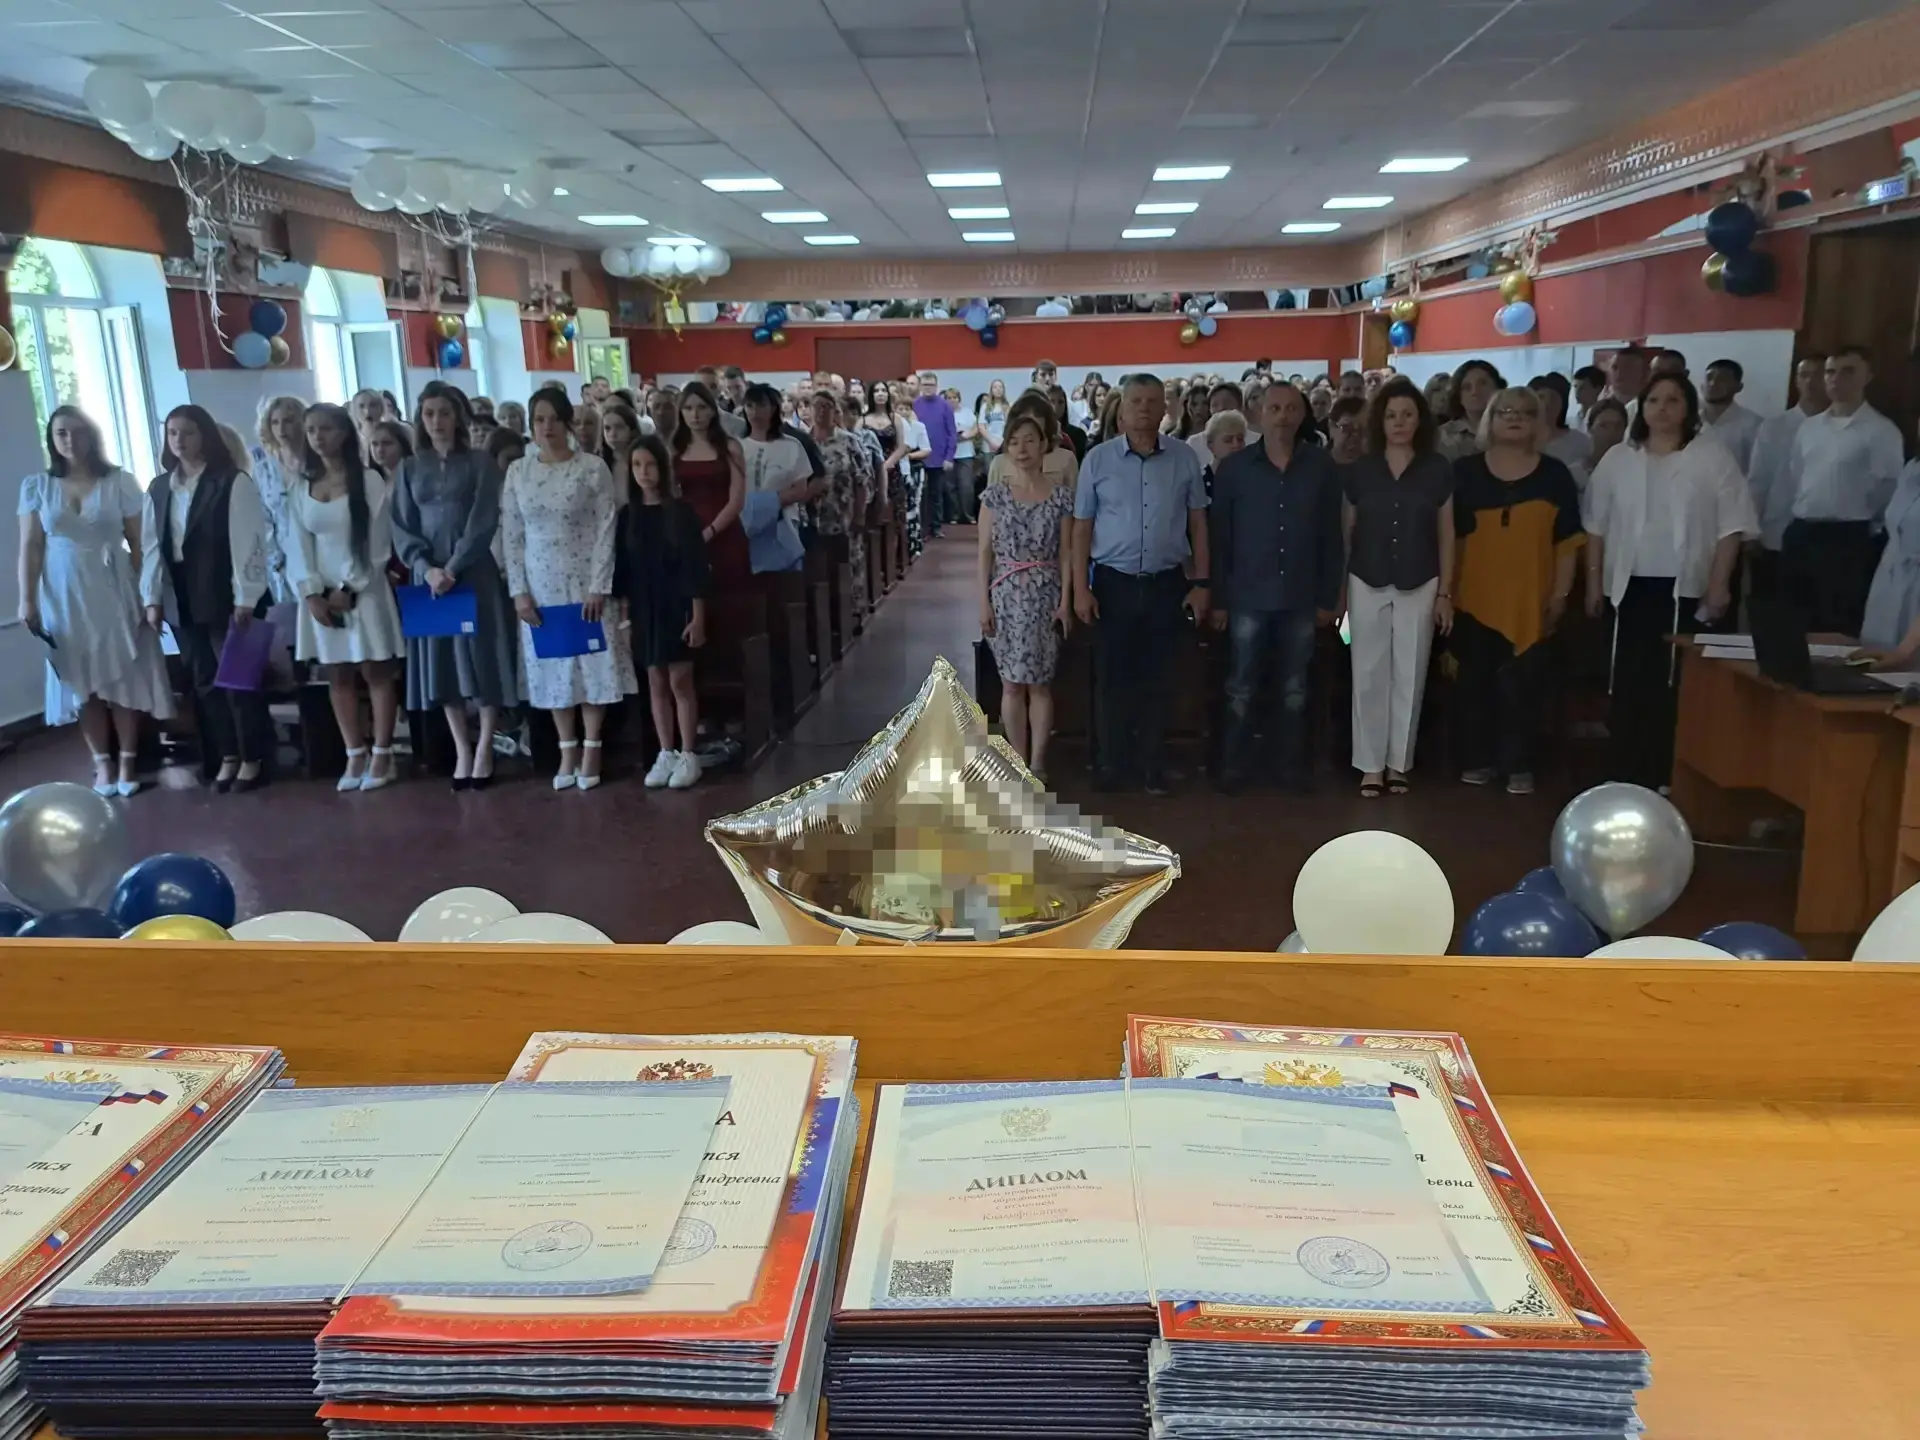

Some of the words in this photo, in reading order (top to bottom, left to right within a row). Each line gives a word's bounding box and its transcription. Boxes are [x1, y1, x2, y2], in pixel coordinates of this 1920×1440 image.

[247, 1167, 375, 1183] ДИПЛОМ
[693, 1172, 781, 1187] Андреевна
[965, 1168, 1088, 1193] ДИПЛОМ
